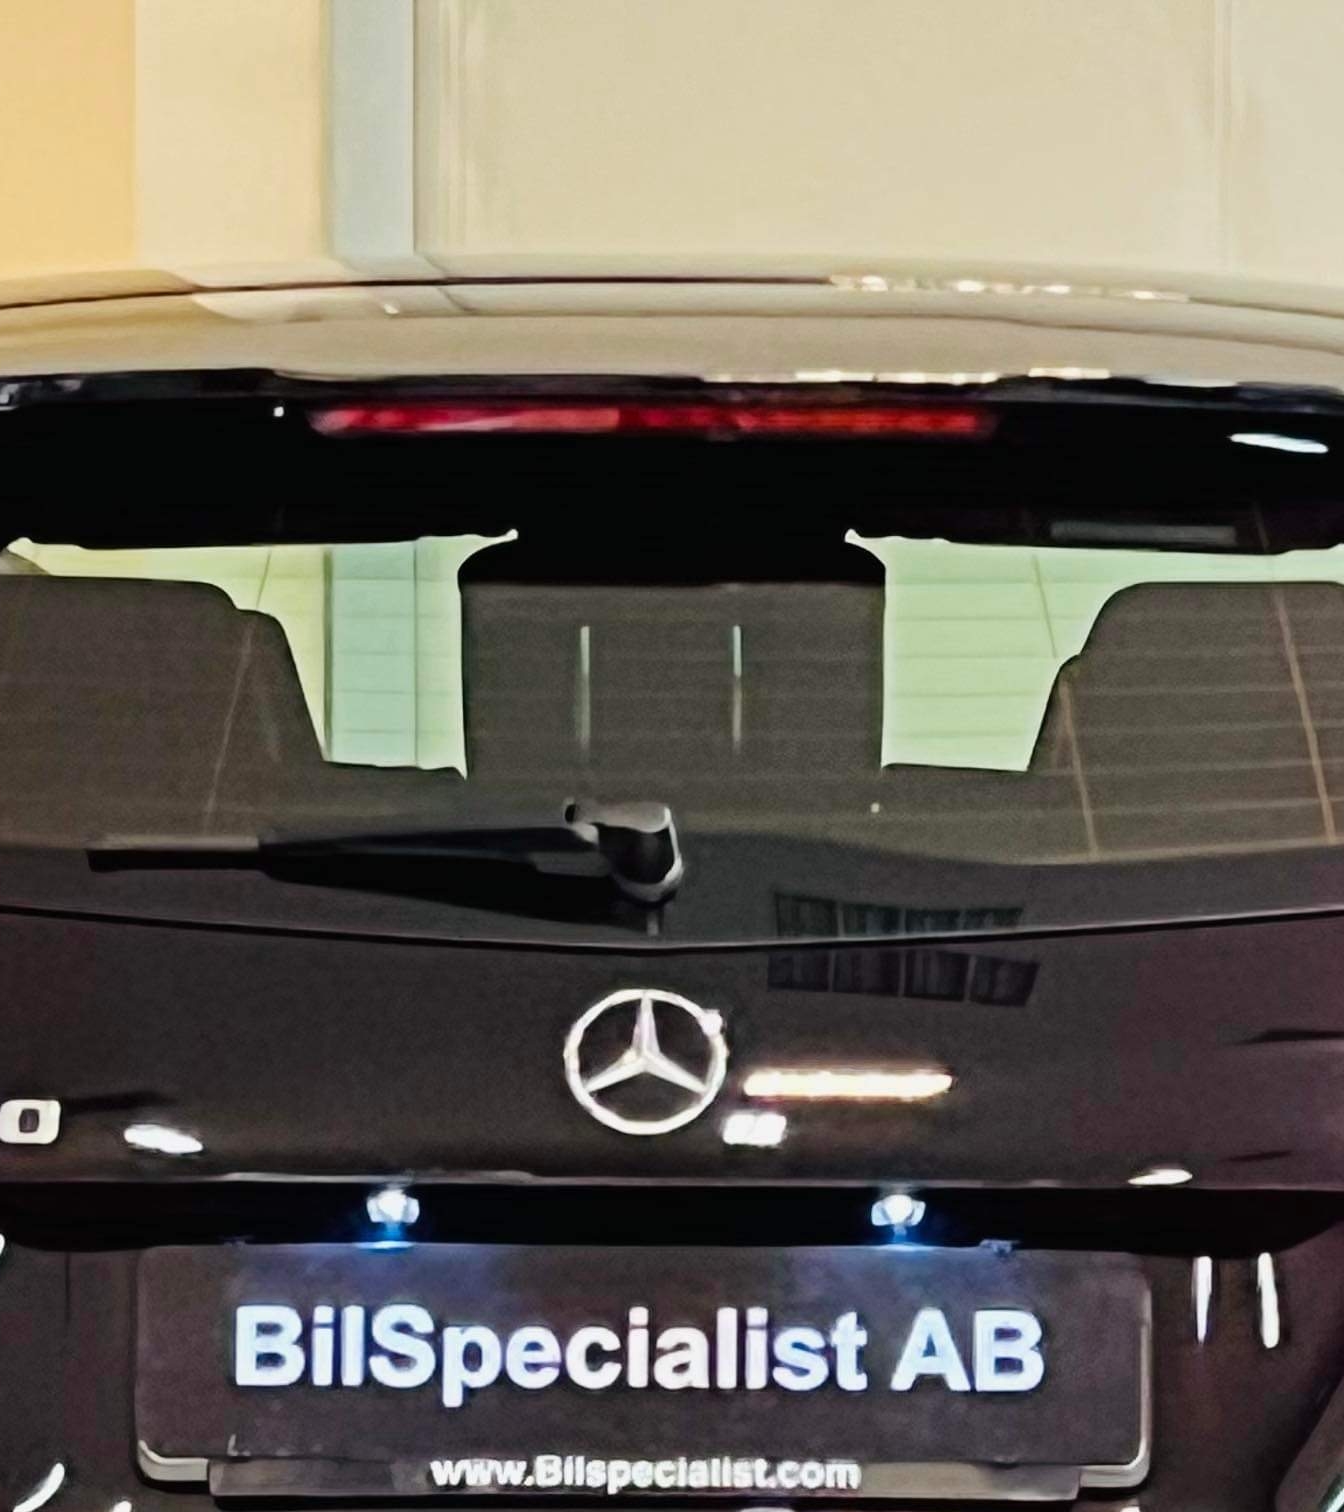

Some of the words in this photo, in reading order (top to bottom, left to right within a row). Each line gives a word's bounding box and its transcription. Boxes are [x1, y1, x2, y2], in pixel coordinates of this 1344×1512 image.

[234, 1304, 869, 1407] BilSpecialist
[890, 1308, 1044, 1394] AB
[429, 1455, 863, 1494] www.Bilspecialist.com
